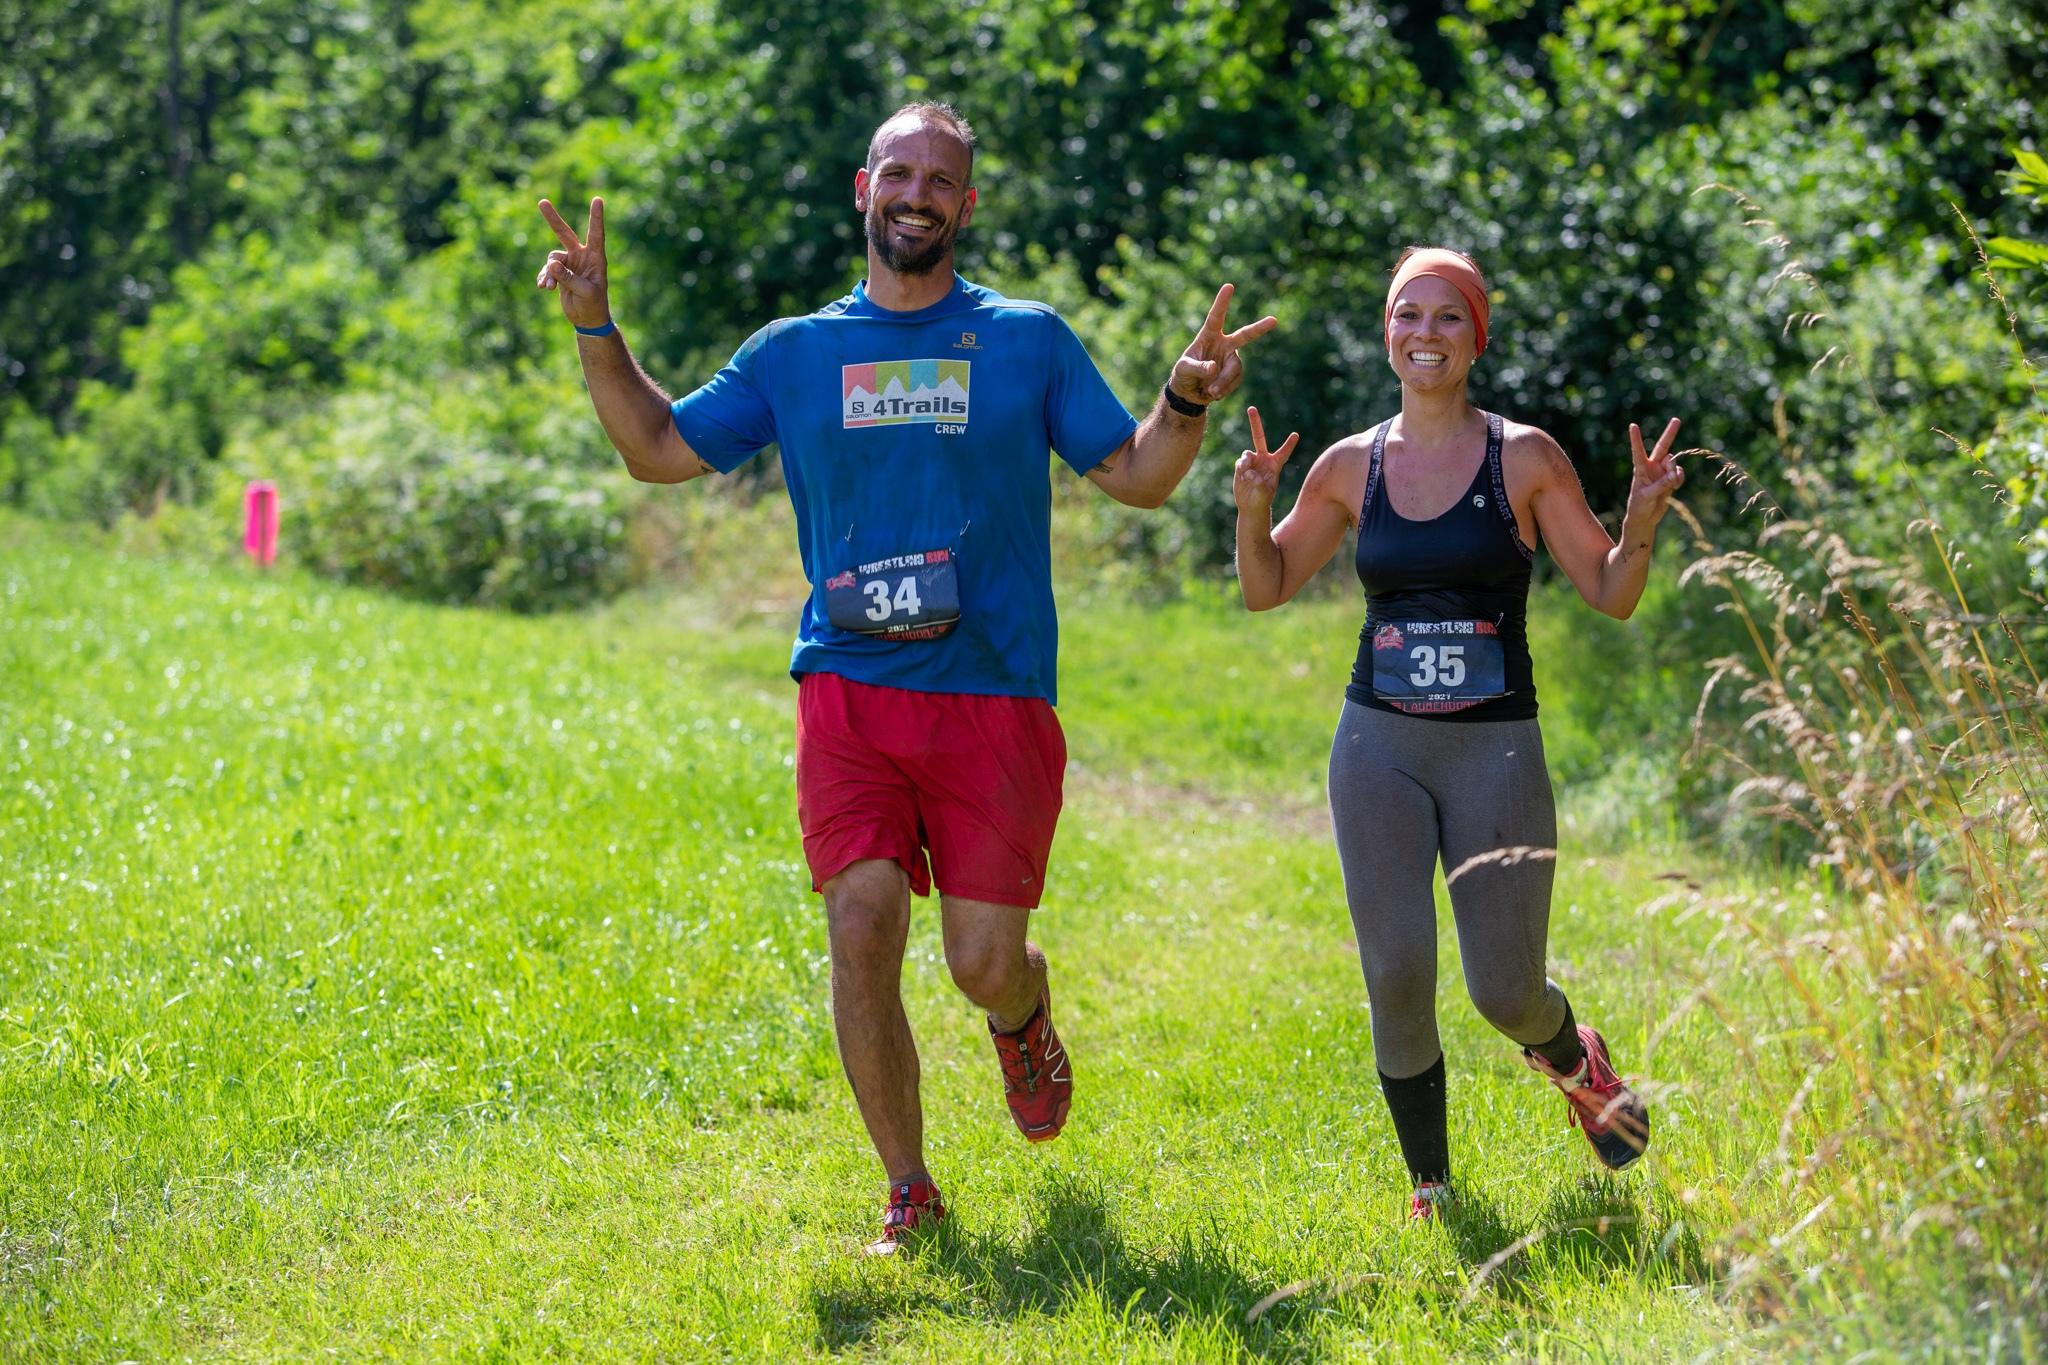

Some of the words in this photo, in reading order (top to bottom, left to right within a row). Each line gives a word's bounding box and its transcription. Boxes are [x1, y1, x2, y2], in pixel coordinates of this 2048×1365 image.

[873, 397, 966, 416] 4Trails
[935, 424, 966, 434] CREW
[1489, 445, 1501, 485] OCEANS
[1493, 487, 1513, 520] APART
[859, 554, 925, 574] WRESTLING
[926, 550, 949, 564] RUN
[864, 576, 921, 621] 34
[887, 623, 910, 633] 2021
[1407, 621, 1474, 634] WRESTLING
[1409, 645, 1466, 687] 35
